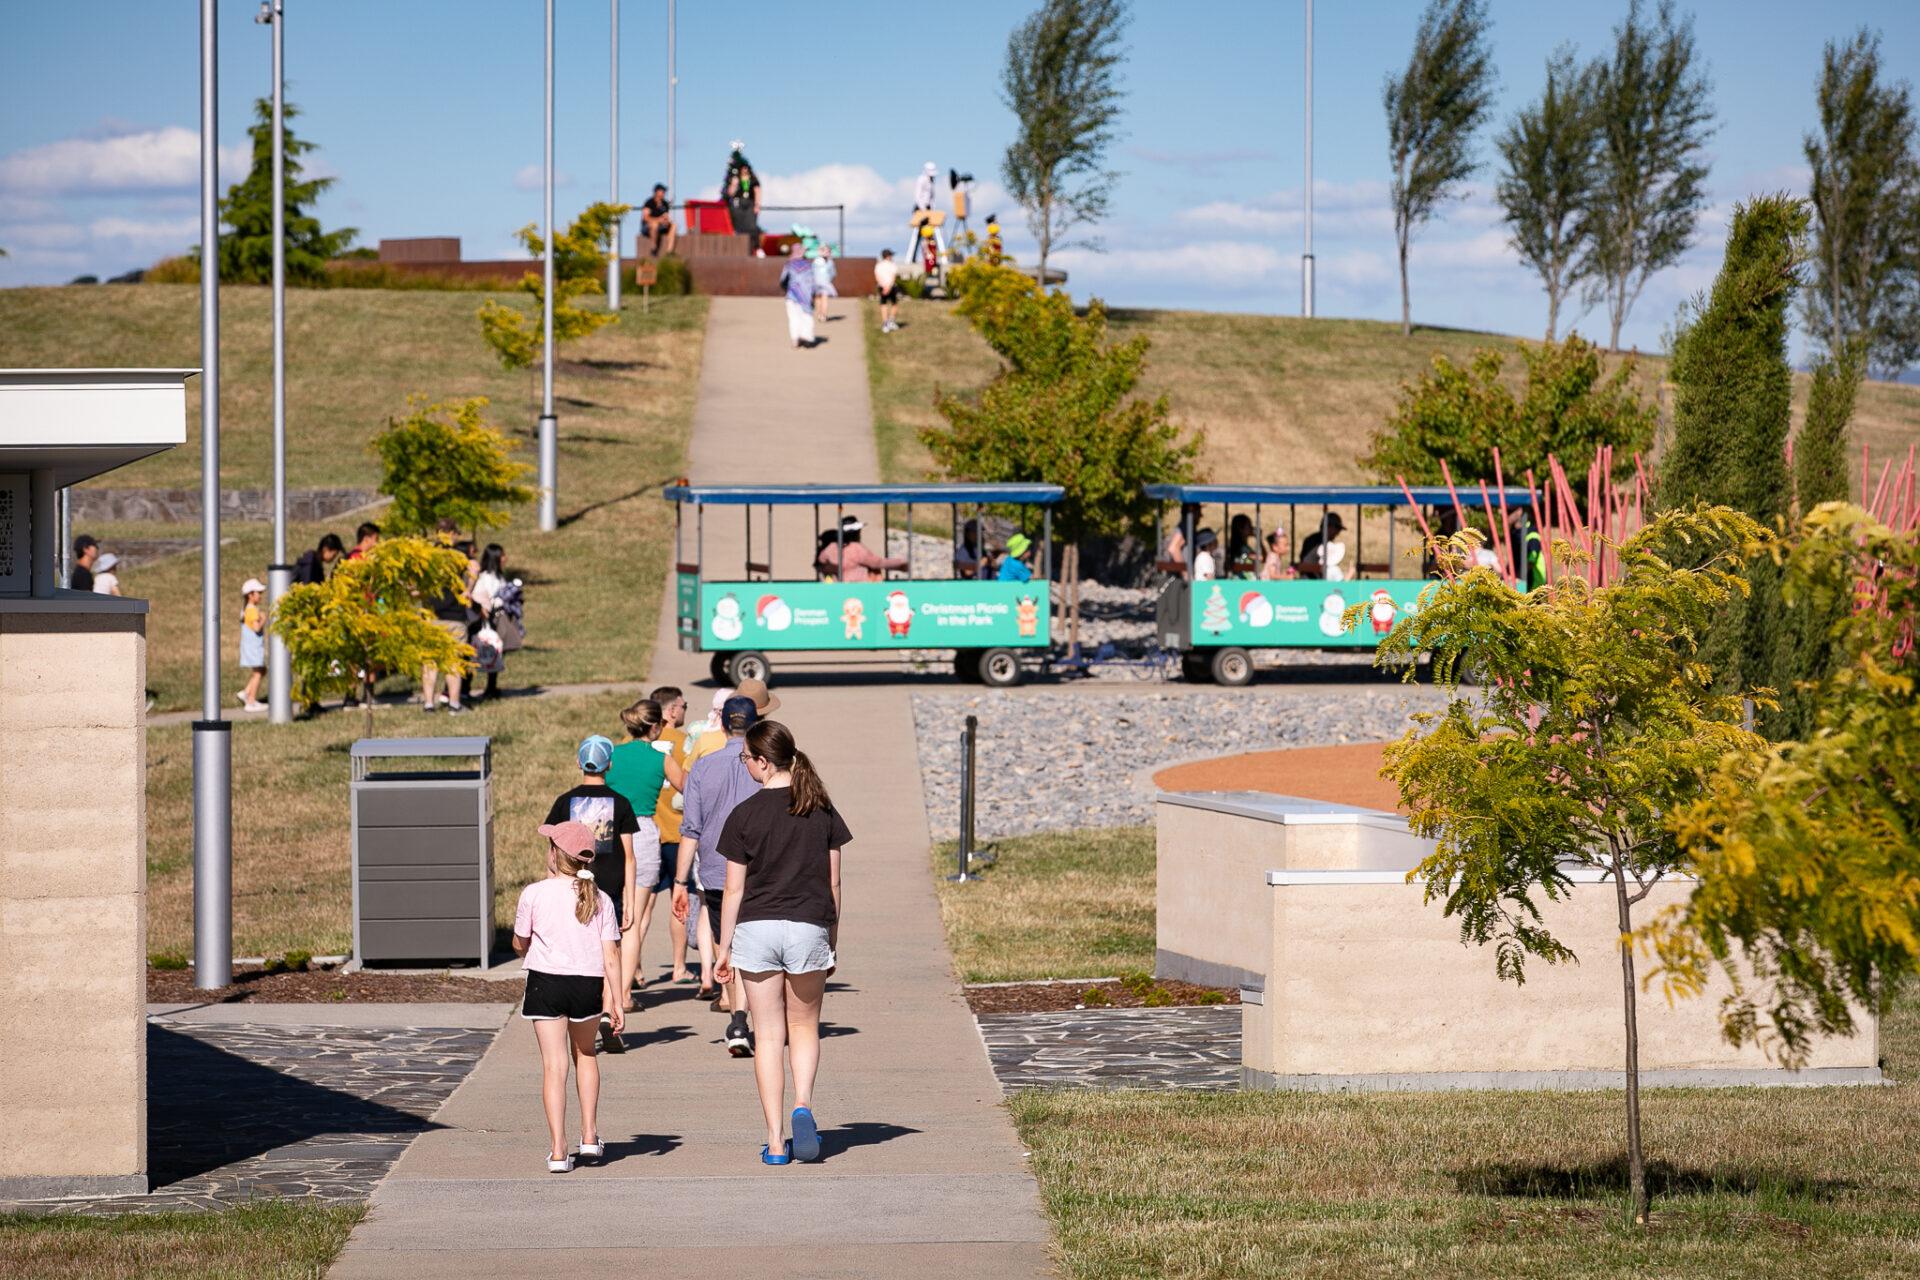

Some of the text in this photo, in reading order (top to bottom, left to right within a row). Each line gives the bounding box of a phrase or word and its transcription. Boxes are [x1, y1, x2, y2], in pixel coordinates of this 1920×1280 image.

[921, 603, 1008, 614] Christmas Picnic
[949, 615, 967, 625] the
[968, 614, 993, 625] Park
